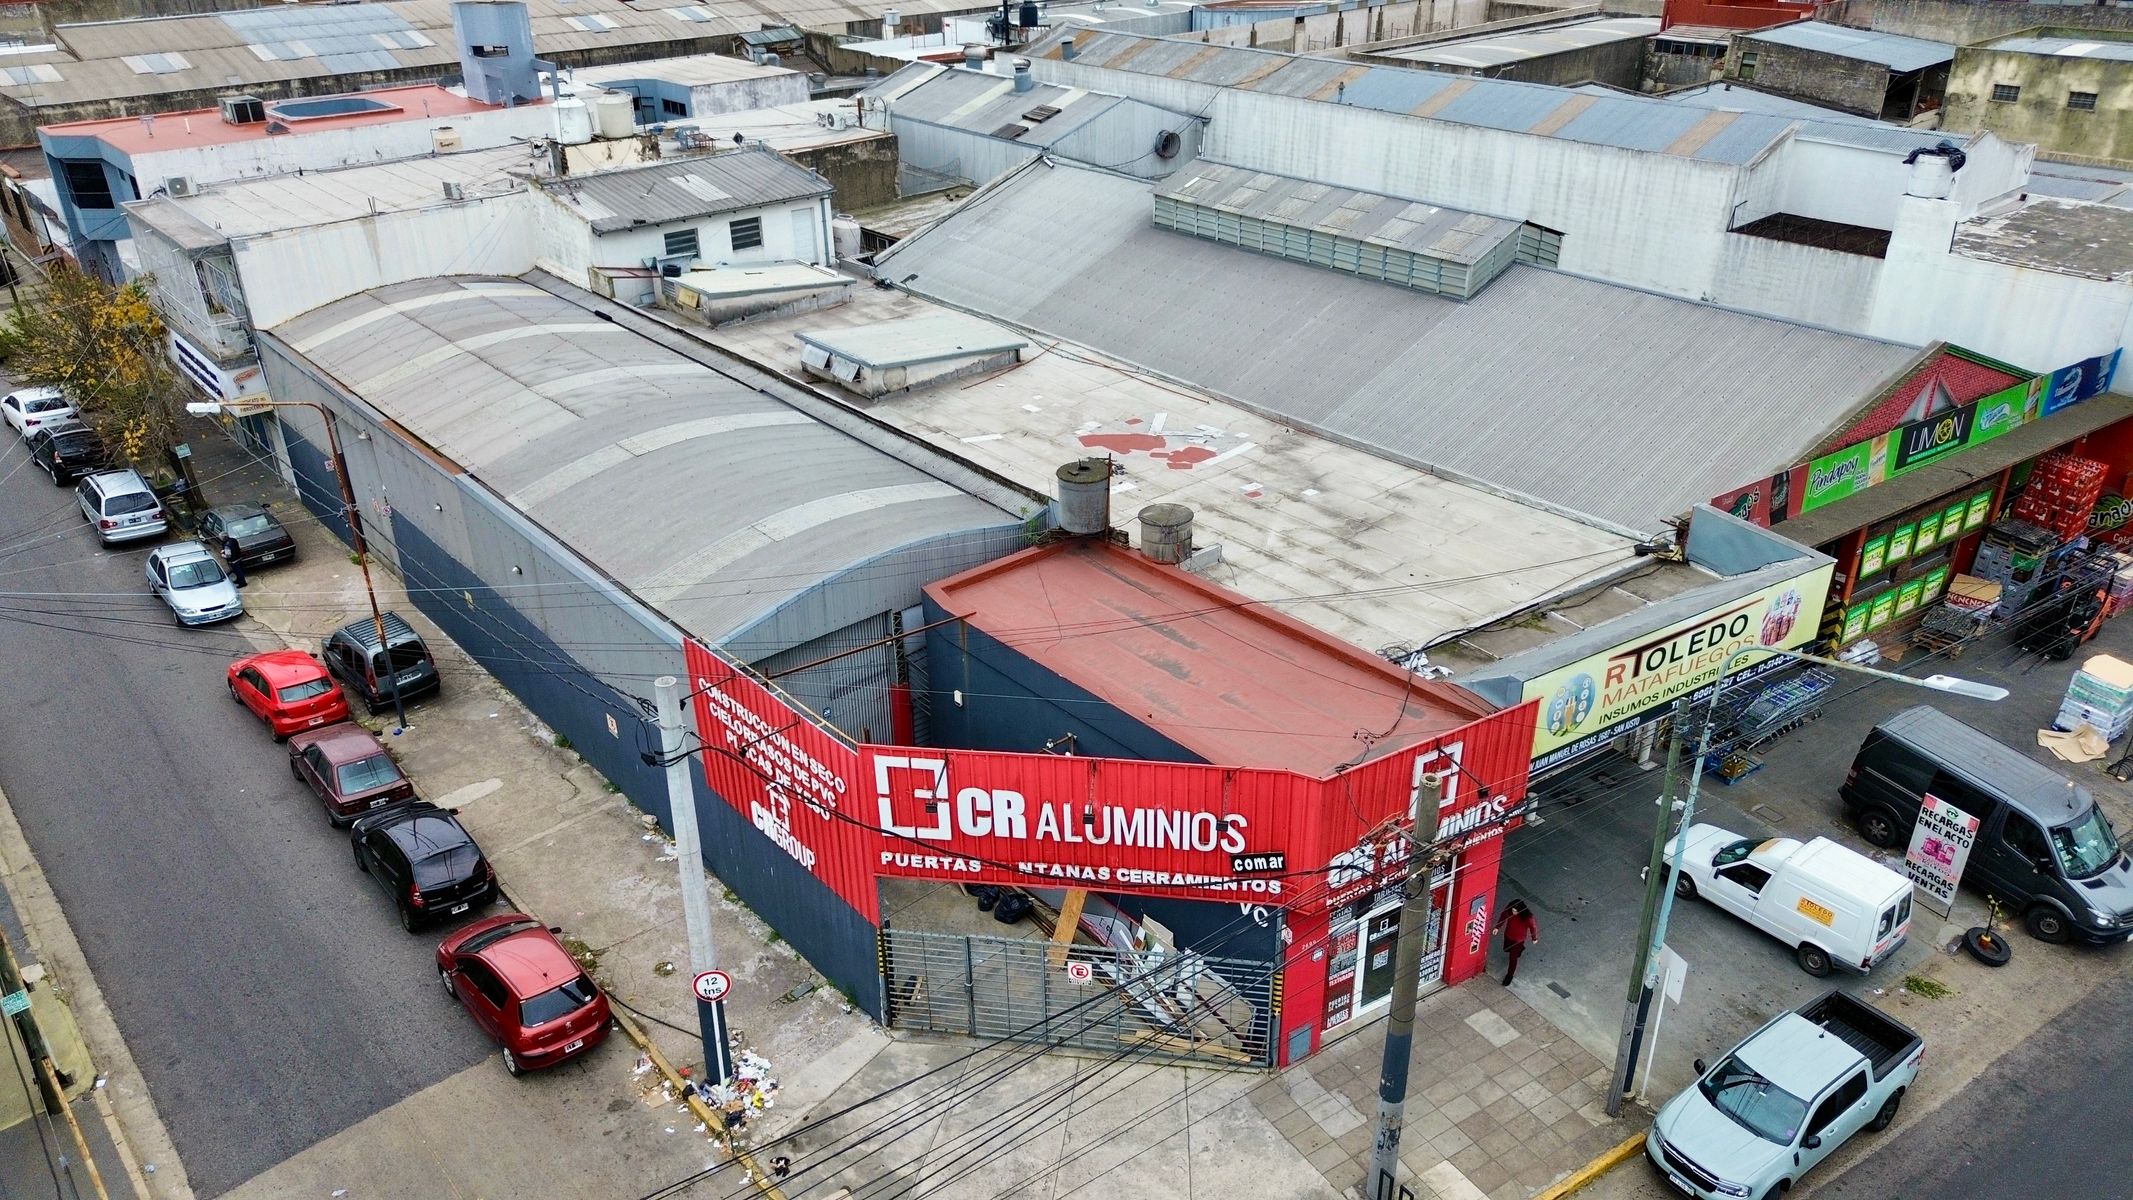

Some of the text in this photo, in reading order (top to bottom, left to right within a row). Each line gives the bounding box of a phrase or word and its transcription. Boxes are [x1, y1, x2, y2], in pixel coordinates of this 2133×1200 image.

[1808, 454, 1860, 497] Pindapoy
[1599, 655, 1749, 724] INSUMOS INDUSTRILES
[1602, 634, 1755, 708] MATAFUEGOS
[699, 678, 846, 794] CONSTRUCCIÓN EN SECO
[709, 702, 837, 808] CIELORRASOS DE PVC
[1534, 757, 1549, 770] JUAN
[1549, 747, 1572, 767] MANUEL
[1571, 742, 1580, 753] DE
[1579, 735, 1597, 749] ROSAS
[1614, 722, 1625, 735] SAN
[1625, 716, 1641, 730] JUSTO
[775, 769, 792, 789] DE
[957, 787, 1027, 840] CR
[1036, 801, 1249, 854] ALUMINIOS
[1921, 806, 1973, 839] RECARGAS
[1944, 830, 1970, 849] ACTO
[881, 852, 982, 873] PUERTAS
[1115, 867, 1282, 894] CERRAMIENTOS
[1905, 859, 1954, 892] RECARGAS
[1908, 871, 1948, 899] VENTAS
[705, 977, 718, 985] 12
